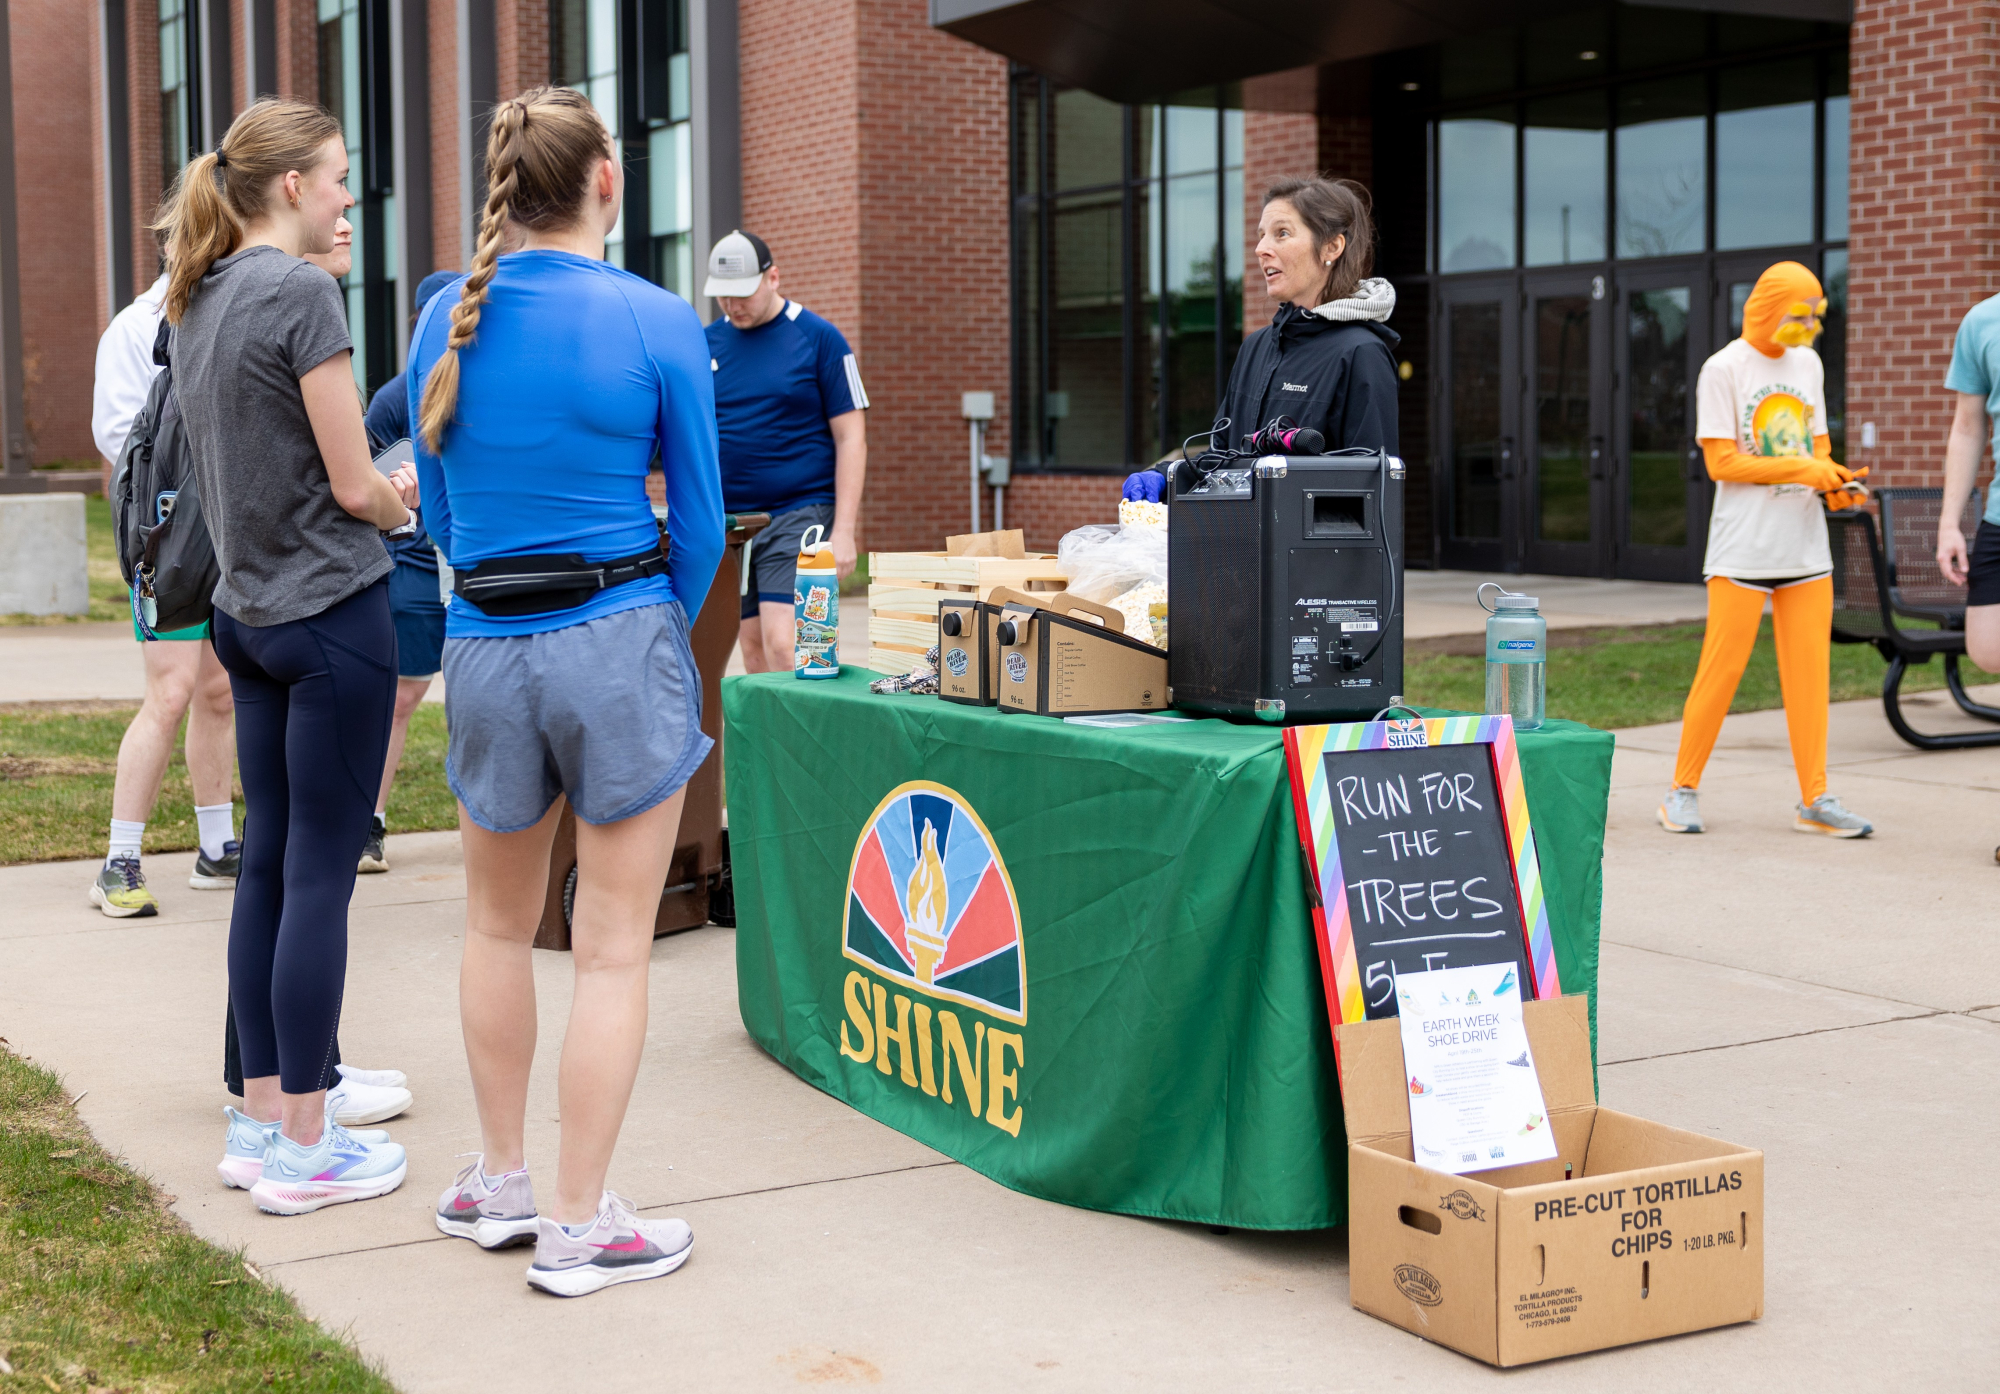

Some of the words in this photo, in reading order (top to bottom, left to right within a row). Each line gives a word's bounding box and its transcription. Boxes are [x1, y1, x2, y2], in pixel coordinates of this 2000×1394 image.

[1592, 274, 1605, 300] 3
[1281, 382, 1308, 392] Marmot
[1295, 598, 1327, 606] ALESIS
[1507, 641, 1535, 650] nalgene
[952, 684, 958, 692] 96
[1010, 694, 1017, 704] 96
[1388, 733, 1427, 747] SHINE
[1336, 774, 1412, 826] RUN
[1417, 771, 1483, 815] FOR
[1378, 829, 1442, 861] THE
[1347, 876, 1504, 928] TREES
[1422, 1017, 1462, 1033] EARTH
[1464, 1013, 1500, 1028] WEEK
[1428, 1032, 1460, 1048] SHOE
[1462, 1027, 1498, 1044] DRIVE
[839, 970, 1025, 1138] SHINE
[1534, 1188, 1626, 1222] PRE-CUT
[1632, 1170, 1743, 1206] TORTILLAS
[1620, 1207, 1663, 1233] FOR
[1611, 1229, 1673, 1258] CHIPS
[1683, 1236, 1701, 1252] 1-20
[1702, 1234, 1716, 1249] LB.
[1717, 1230, 1736, 1245] PKG.
[1398, 1271, 1408, 1284] EL
[1407, 1269, 1438, 1295] MILAGRO
[1514, 1302, 1546, 1312] TORTILLA
[1547, 1294, 1583, 1307] PRODUCTS
[1520, 1294, 1528, 1302] EL
[1564, 1286, 1577, 1295] INC.
[1518, 1309, 1551, 1321] CHICAGO,
